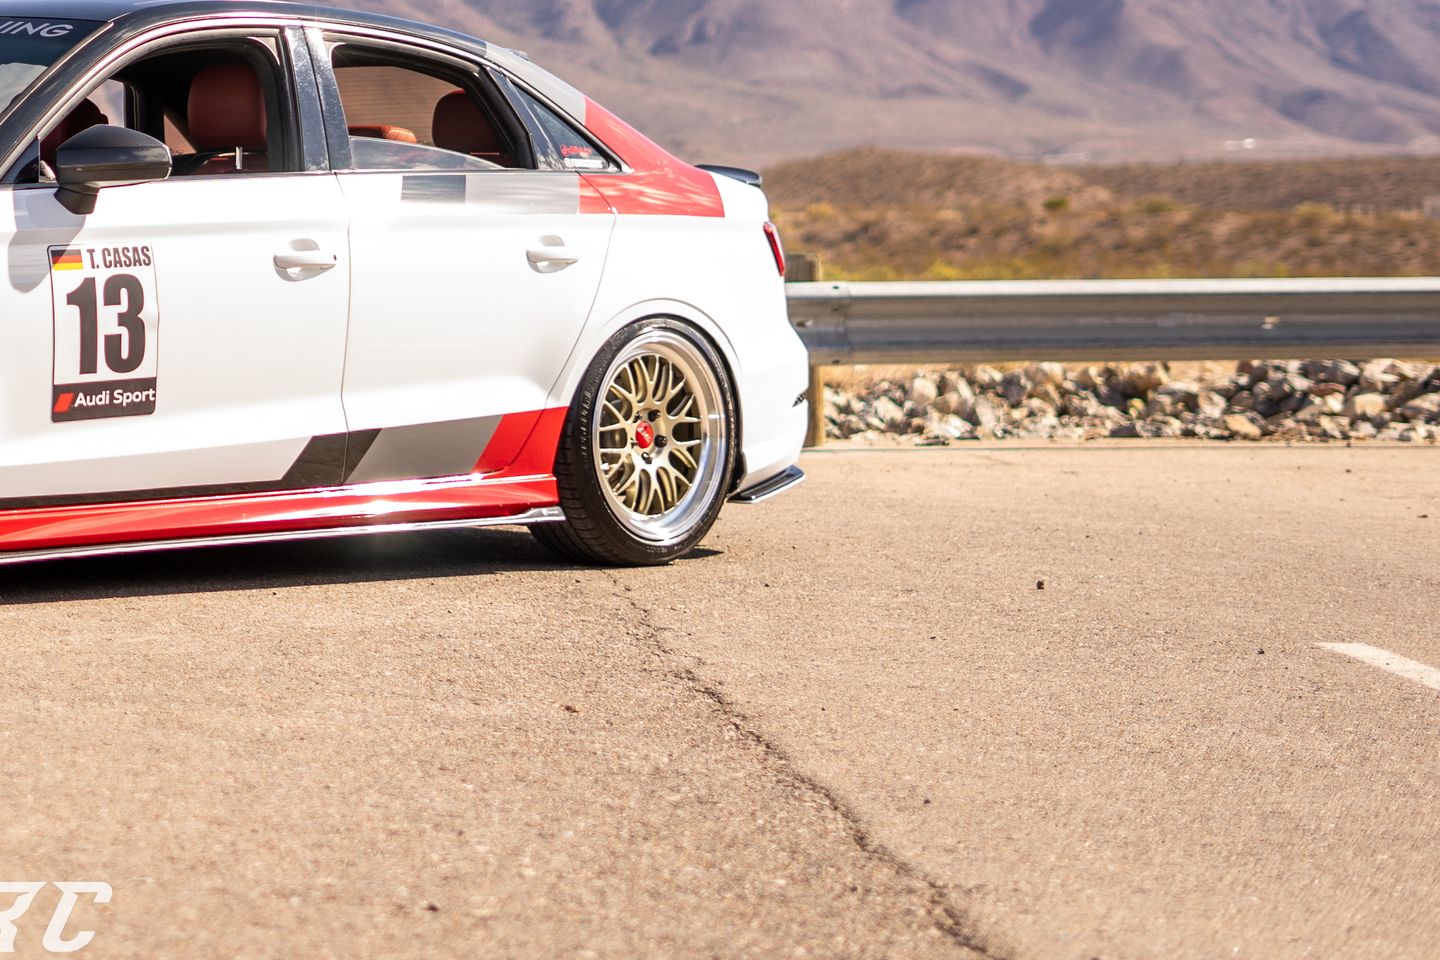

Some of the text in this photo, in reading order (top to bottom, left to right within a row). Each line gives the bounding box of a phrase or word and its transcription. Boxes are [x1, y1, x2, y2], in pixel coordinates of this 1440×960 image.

[87, 245, 152, 269] T. CASAS
[66, 273, 146, 375] 13
[74, 388, 156, 408] Audi Sport
